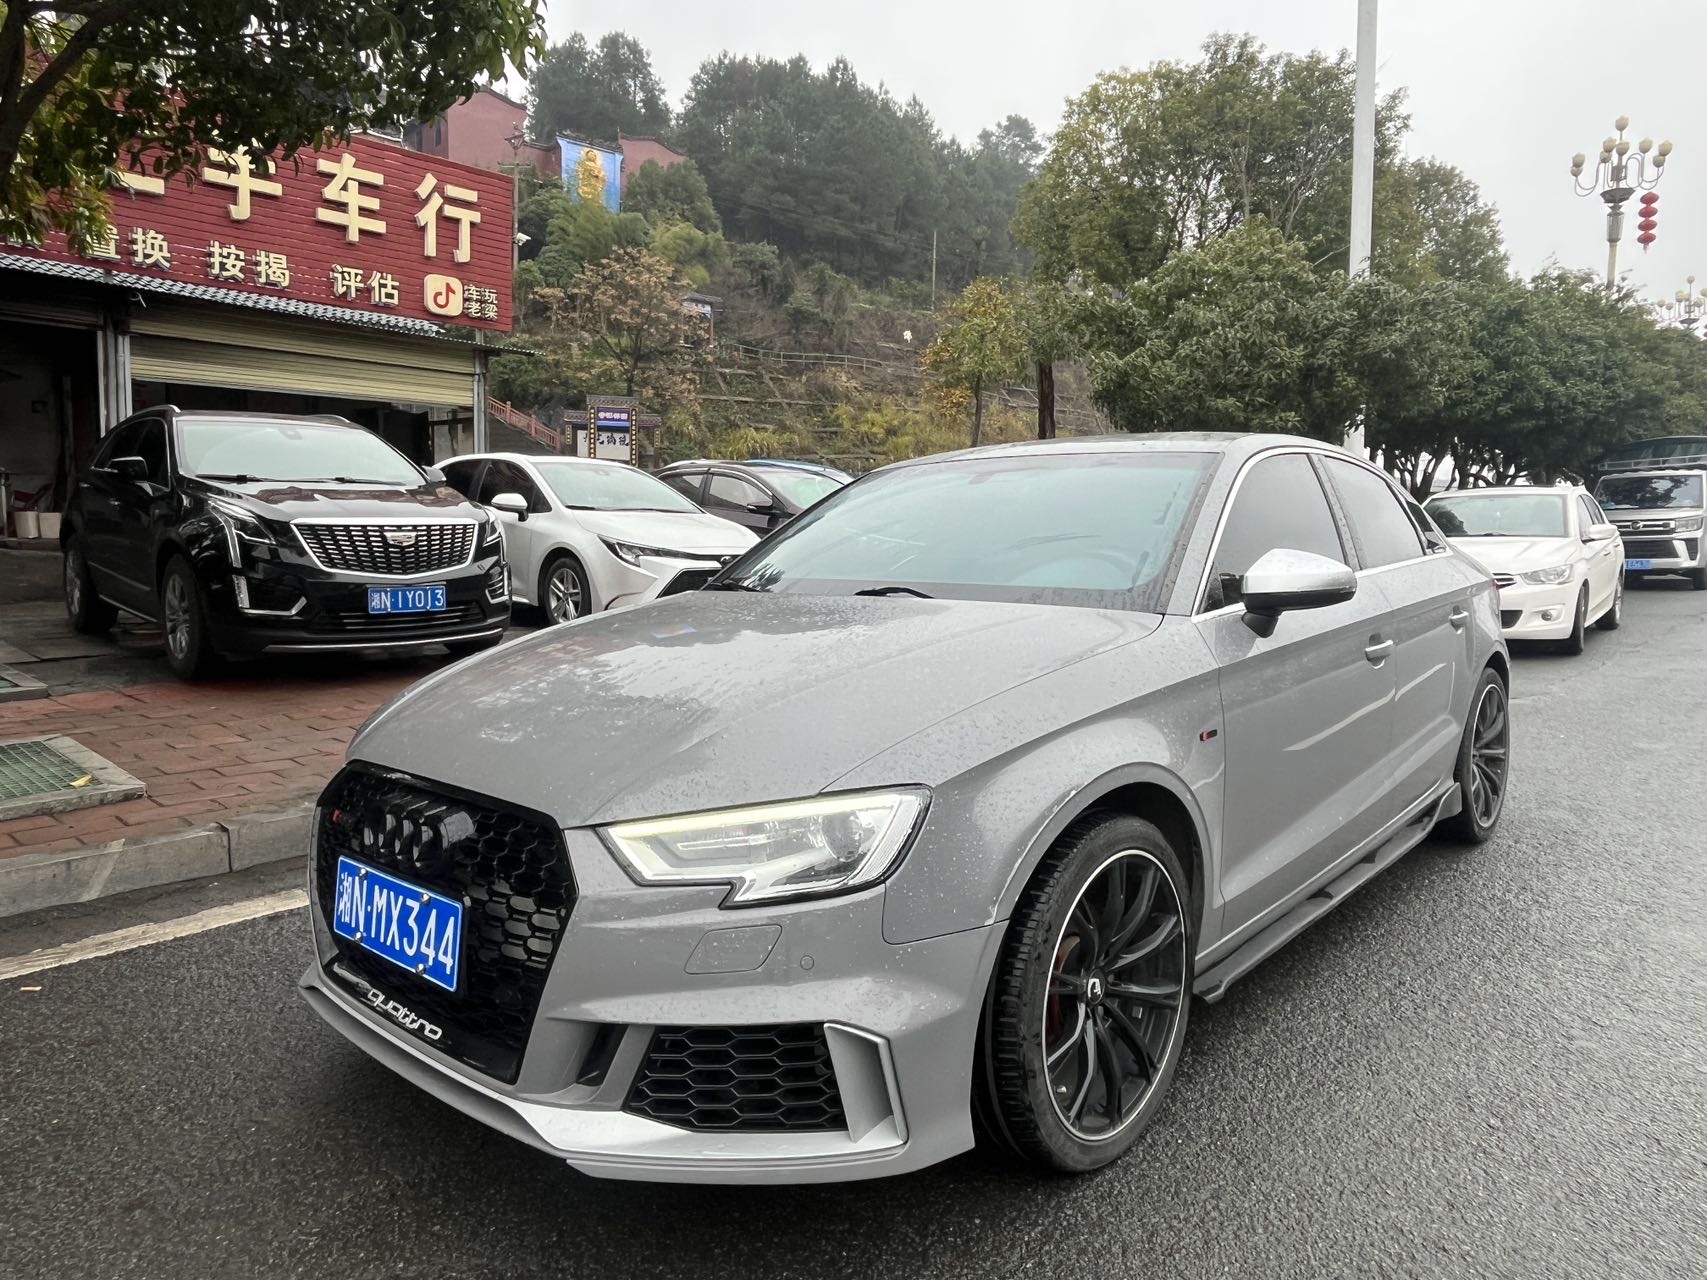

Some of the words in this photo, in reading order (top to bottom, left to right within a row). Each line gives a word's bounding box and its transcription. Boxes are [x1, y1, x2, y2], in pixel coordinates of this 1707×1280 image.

[209, 240, 291, 288] 按揭
[332, 263, 400, 306] 评估
[367, 988, 443, 1041] quattro
